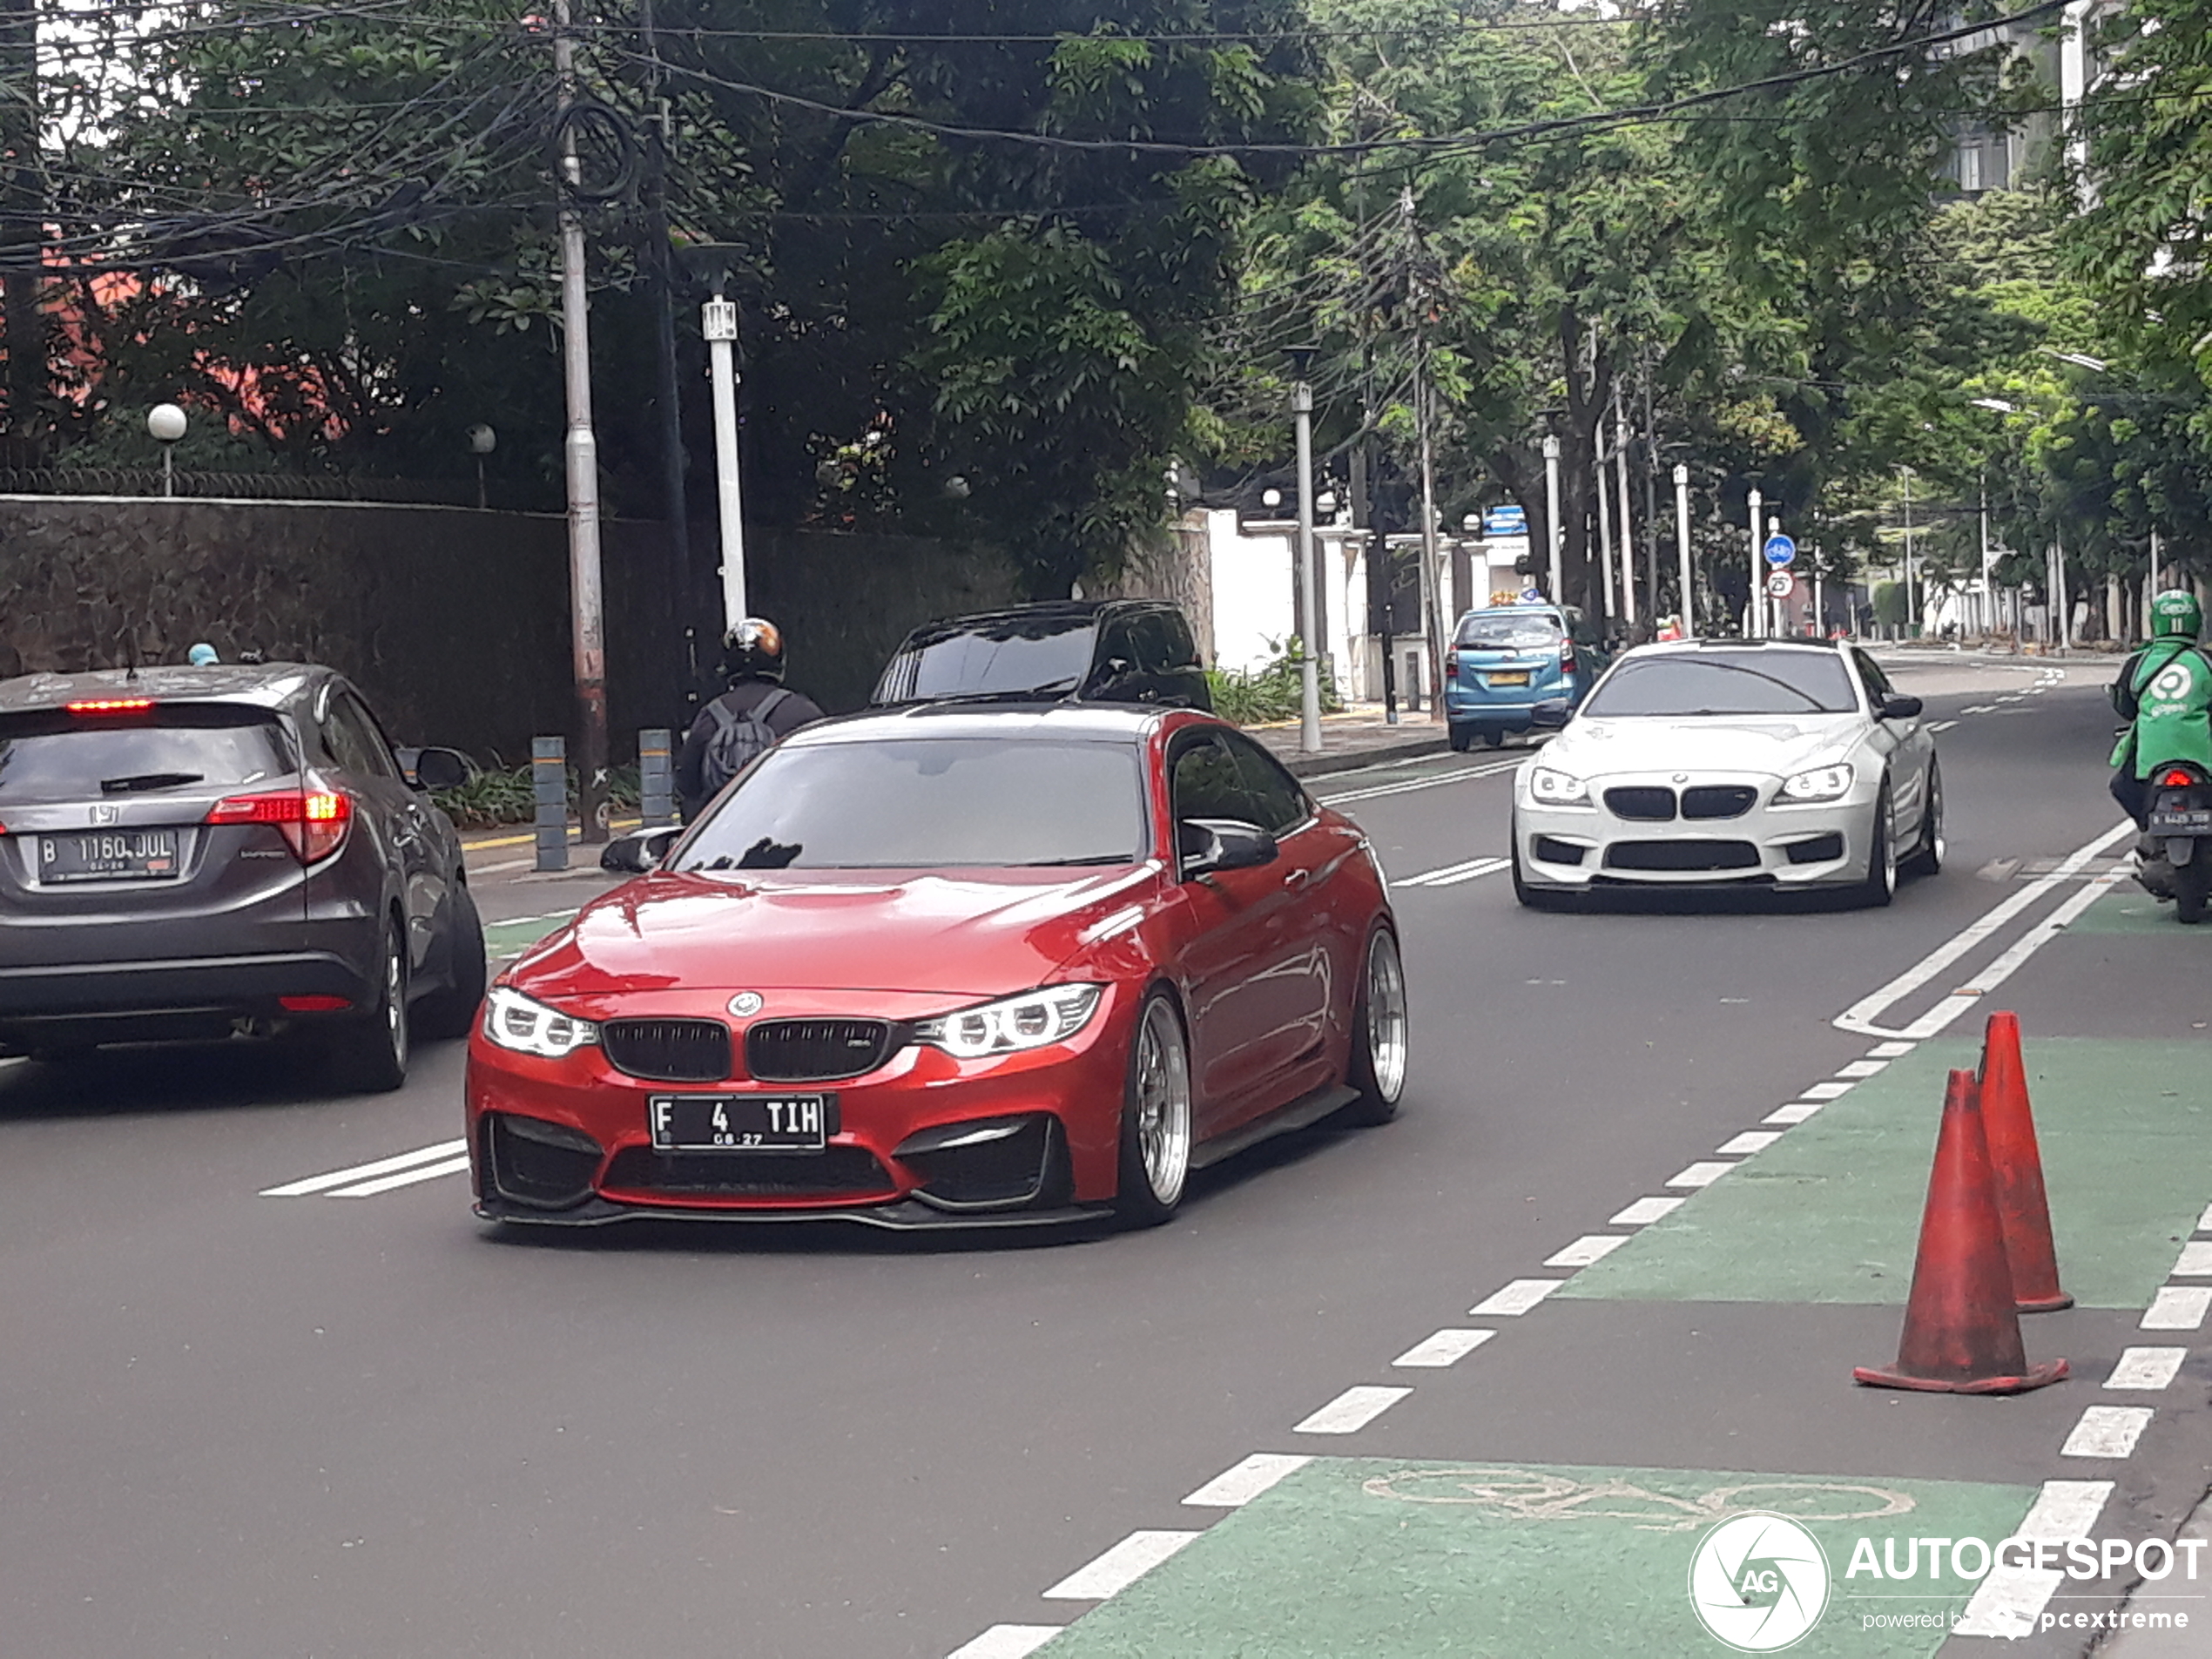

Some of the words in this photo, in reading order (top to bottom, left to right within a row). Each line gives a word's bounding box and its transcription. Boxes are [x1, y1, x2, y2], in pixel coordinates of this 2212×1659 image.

[1771, 576, 1789, 591] 25
[44, 839, 56, 863] B
[79, 836, 126, 860] 1160
[136, 833, 172, 858] JUL
[657, 1103, 672, 1131] F
[712, 1103, 728, 1132] 4
[767, 1103, 819, 1132] TIH
